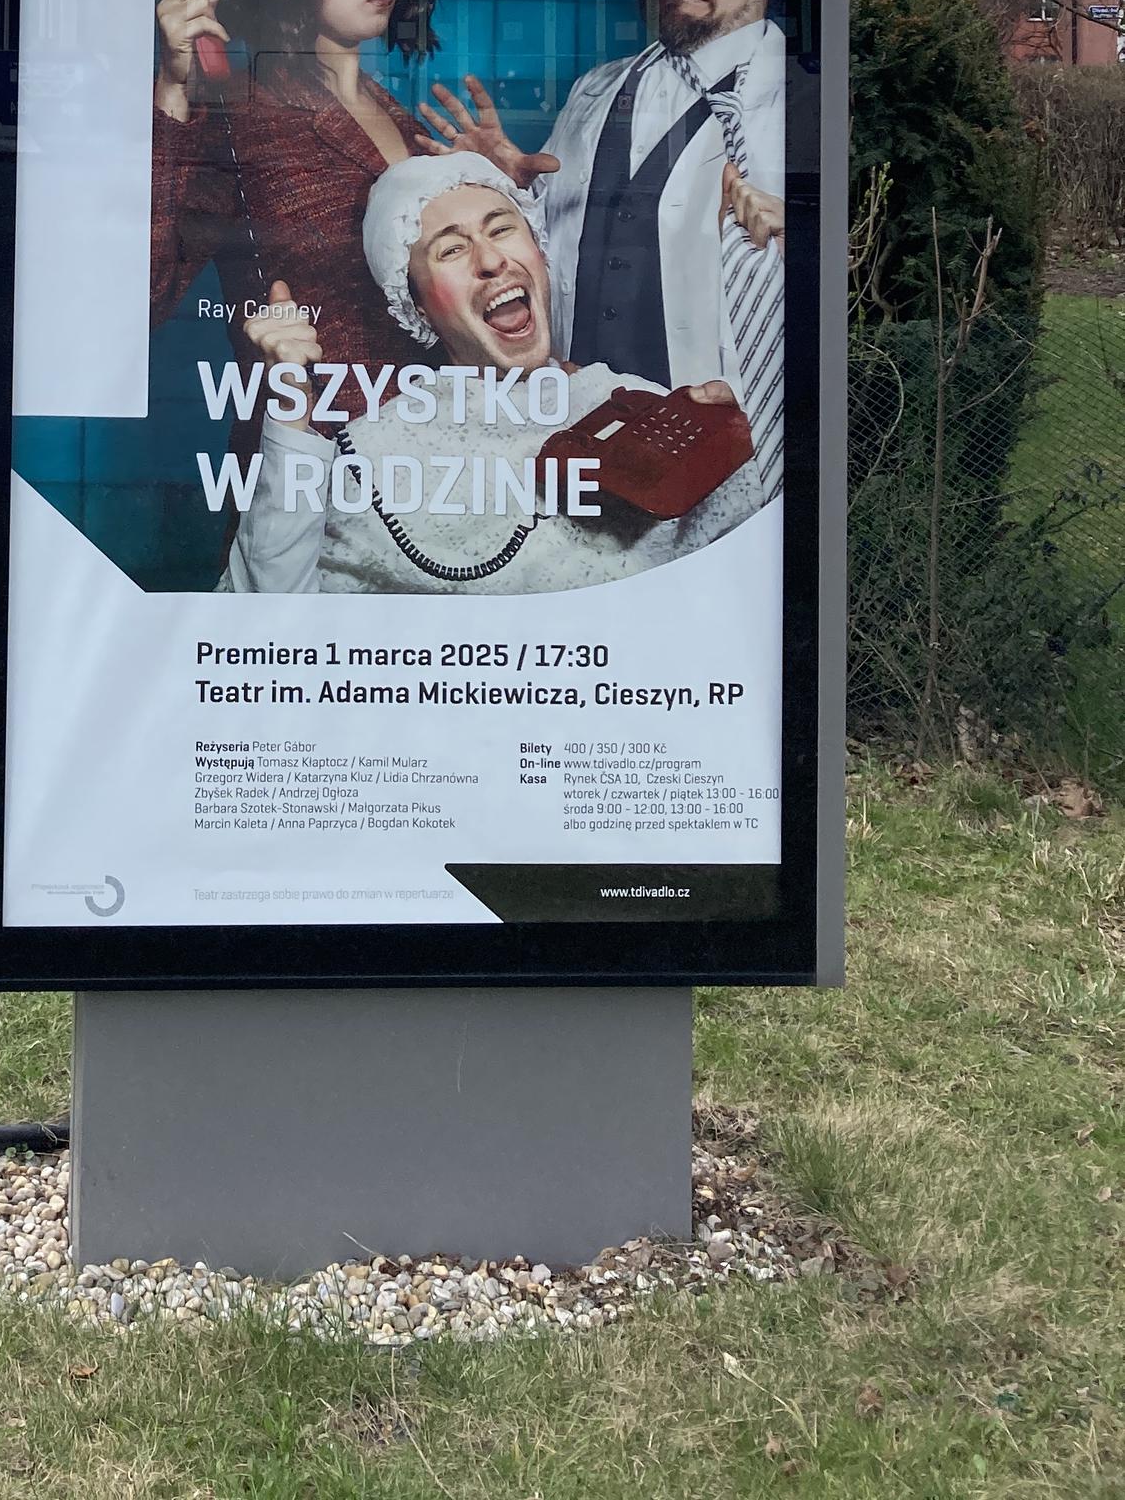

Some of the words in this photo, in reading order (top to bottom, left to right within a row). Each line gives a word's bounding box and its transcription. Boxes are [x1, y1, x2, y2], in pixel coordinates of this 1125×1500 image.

[198, 300, 236, 323] Ray
[244, 301, 321, 323] Cooney
[197, 361, 570, 425] WSZYSTKO
[196, 453, 263, 512] W
[284, 455, 602, 516] RODZINIE
[198, 642, 317, 665] Premiera
[326, 643, 340, 664] 1
[349, 649, 431, 665] marca
[441, 644, 508, 666] 2025
[517, 644, 527, 671] /
[536, 645, 608, 667] 17:30
[195, 681, 264, 702] Teatr
[272, 680, 310, 703] im.
[319, 680, 409, 703] Adama
[419, 682, 585, 708] Mickiewicza,
[595, 683, 699, 711] Cieszyn,
[710, 683, 743, 704] RP
[196, 742, 249, 754] Reżyseria
[253, 742, 281, 752] Peter
[284, 742, 316, 752] Gábor
[520, 744, 551, 755] Bilety
[564, 744, 586, 754] 400
[589, 743, 593, 755] /
[597, 744, 617, 754] 350
[621, 743, 625, 755] /
[628, 744, 650, 754] 300
[654, 743, 667, 754] Kč
[196, 757, 254, 770] Występują
[257, 757, 298, 768] Tomasz
[302, 757, 347, 770] Kłaptocz
[351, 757, 355, 769] /
[359, 757, 389, 768] Kamil
[392, 757, 427, 768] Mularz
[520, 759, 561, 769] On-line
[564, 759, 701, 771] www.tdivadlo.cz/program
[195, 773, 243, 785] Grzegorz
[246, 773, 283, 783] Widera
[287, 773, 291, 785] /
[294, 773, 347, 785] Katarzyna
[351, 773, 372, 783] Kluz
[376, 773, 380, 785] /
[384, 773, 408, 783] Lidia
[412, 773, 478, 784] Chrzanówna
[520, 774, 547, 784] Kasa
[564, 774, 597, 786] Rynek
[600, 771, 621, 784] ČSA
[625, 774, 640, 786] 10,
[647, 774, 681, 784] Czeski
[684, 774, 723, 786] Cieszyn
[195, 788, 232, 801] Zbyšek
[236, 787, 269, 798] Radek
[272, 787, 276, 800] /
[279, 787, 319, 801] Andrzej
[322, 787, 358, 801] Ogłoza
[564, 789, 600, 799] wtorek
[604, 788, 608, 801] /
[611, 789, 660, 799] czwartek
[663, 788, 667, 801] /
[671, 788, 703, 802] piątek
[707, 788, 736, 799] 13:00
[749, 788, 779, 799] 16:00
[195, 803, 237, 813] Barbara
[241, 803, 337, 813] Szotek-Stonawski
[341, 803, 345, 815] /
[412, 803, 441, 813] Pikus
[564, 804, 593, 814] środa
[597, 804, 622, 814] 9:00
[634, 804, 667, 816] 12:00,
[671, 804, 701, 814] 13:00
[713, 803, 743, 814] 16:00
[195, 818, 231, 829] Marcin
[234, 818, 267, 829] Kaleta
[271, 818, 275, 830] /
[278, 818, 305, 829] Anna
[308, 818, 357, 831] Paprzyca
[361, 818, 365, 830] /
[368, 818, 409, 831] Bogdan
[412, 818, 455, 828] Kokotek
[564, 819, 586, 829] albo
[589, 819, 631, 832] godzinę
[635, 819, 665, 832] przed
[668, 818, 730, 831] spektaklem
[733, 821, 742, 829] w
[745, 819, 758, 829] TC
[600, 886, 690, 897] www.tdivadlo.cz
